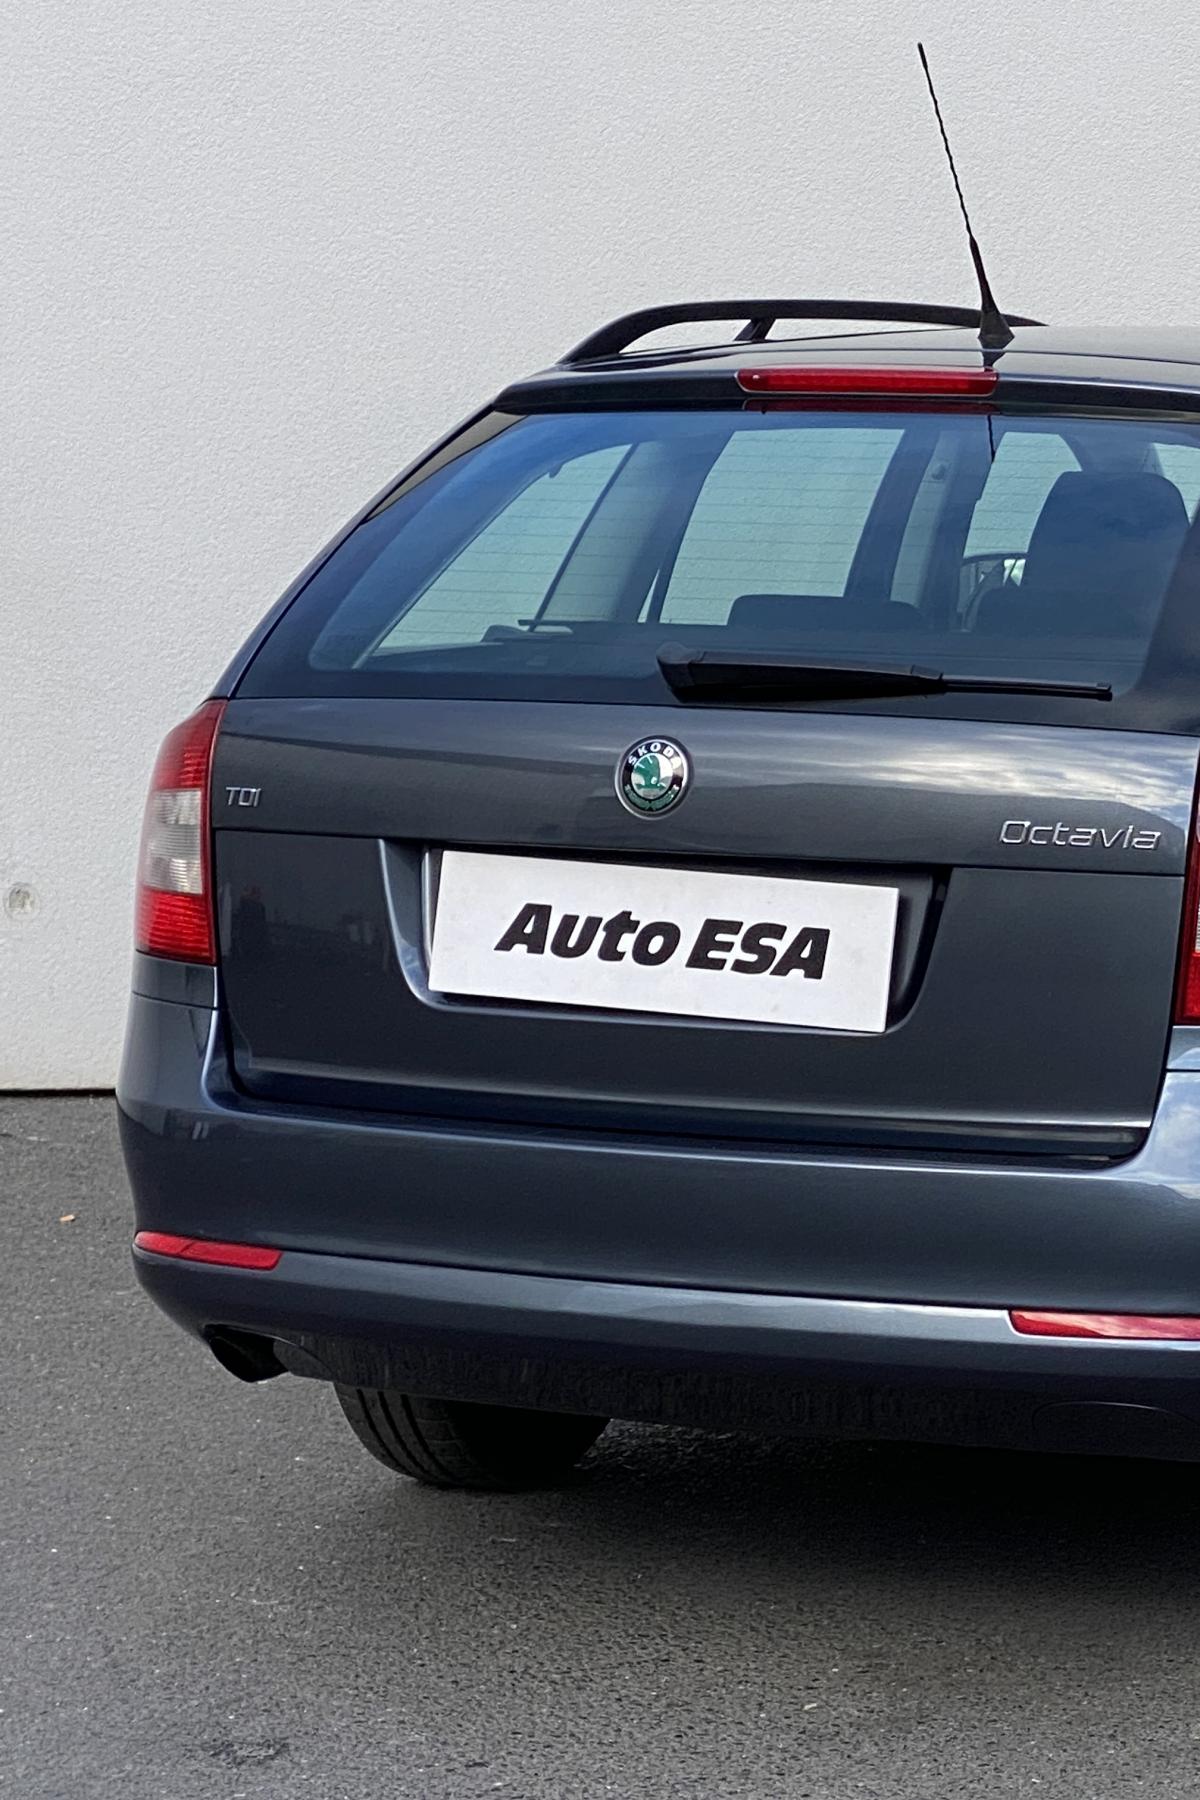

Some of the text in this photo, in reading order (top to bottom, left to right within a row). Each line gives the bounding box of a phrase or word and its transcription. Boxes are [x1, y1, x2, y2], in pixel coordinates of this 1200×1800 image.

[225, 786, 262, 808] TDI
[1000, 820, 1161, 850] Octavia
[493, 902, 831, 980] Auto ESA
